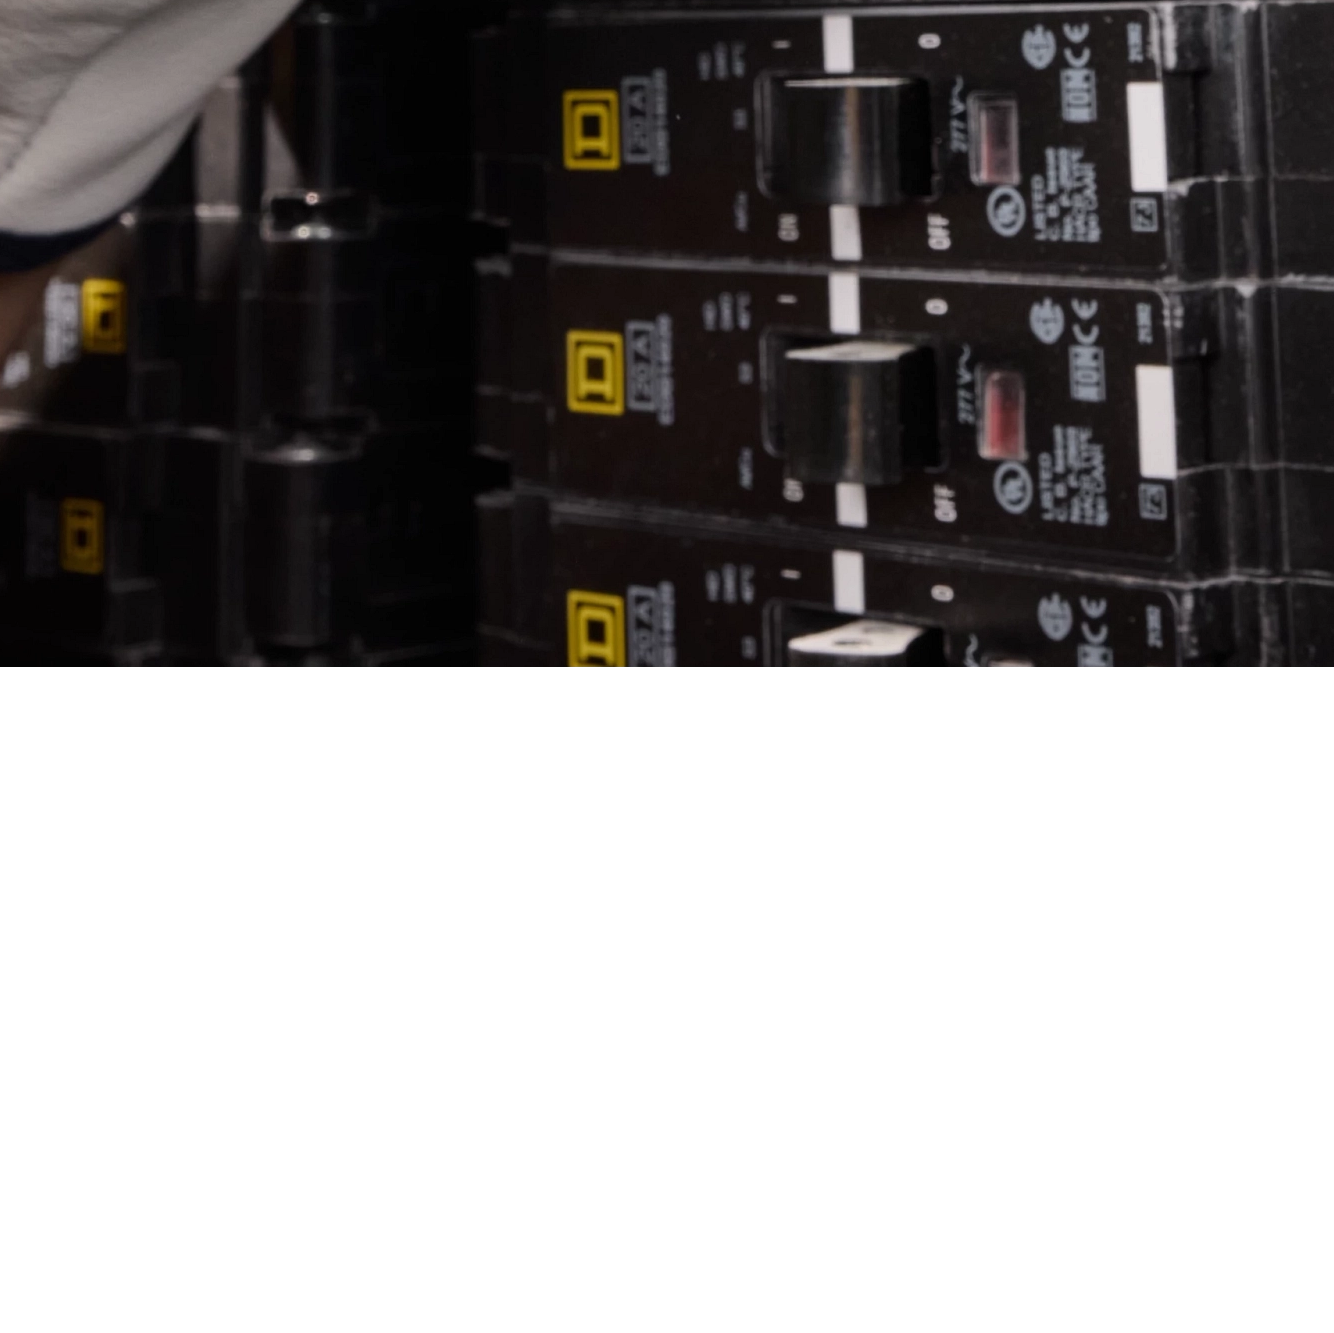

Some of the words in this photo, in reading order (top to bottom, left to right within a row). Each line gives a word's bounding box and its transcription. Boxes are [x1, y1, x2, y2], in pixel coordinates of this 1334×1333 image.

[950, 119, 968, 153] 277
[777, 213, 800, 243] ON
[927, 213, 952, 251] OFF
[956, 390, 976, 425] 277
[933, 483, 959, 523] OFF
[1038, 452, 1055, 521] LISTED
